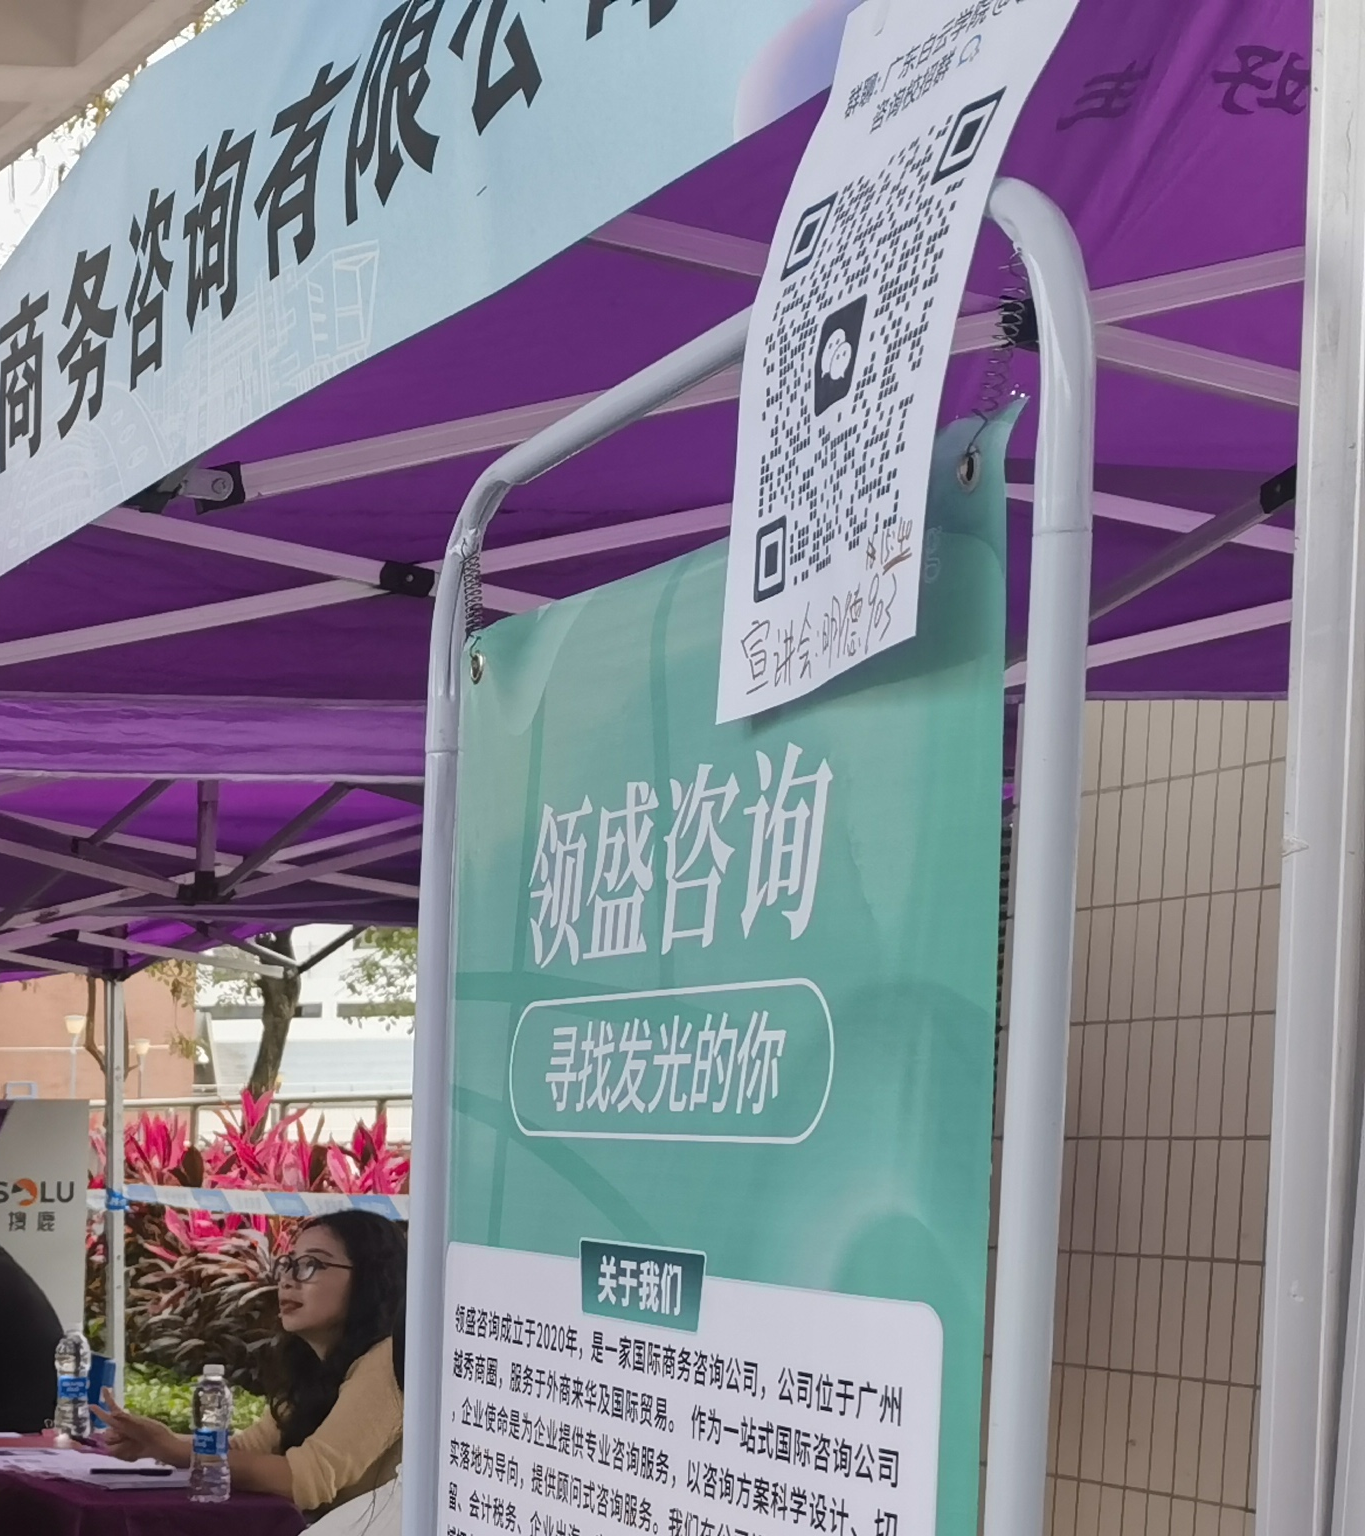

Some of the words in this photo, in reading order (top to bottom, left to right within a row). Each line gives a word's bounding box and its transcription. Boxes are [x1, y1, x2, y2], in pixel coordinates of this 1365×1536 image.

[528, 741, 833, 969] 领盛咨询
[545, 1009, 787, 1115] 寻找发光的你
[598, 1256, 682, 1318] 关于我们
[455, 1304, 903, 1426] 领盛咨询成立于2020年，是一家国际商务咨询公司，公司位于广州
